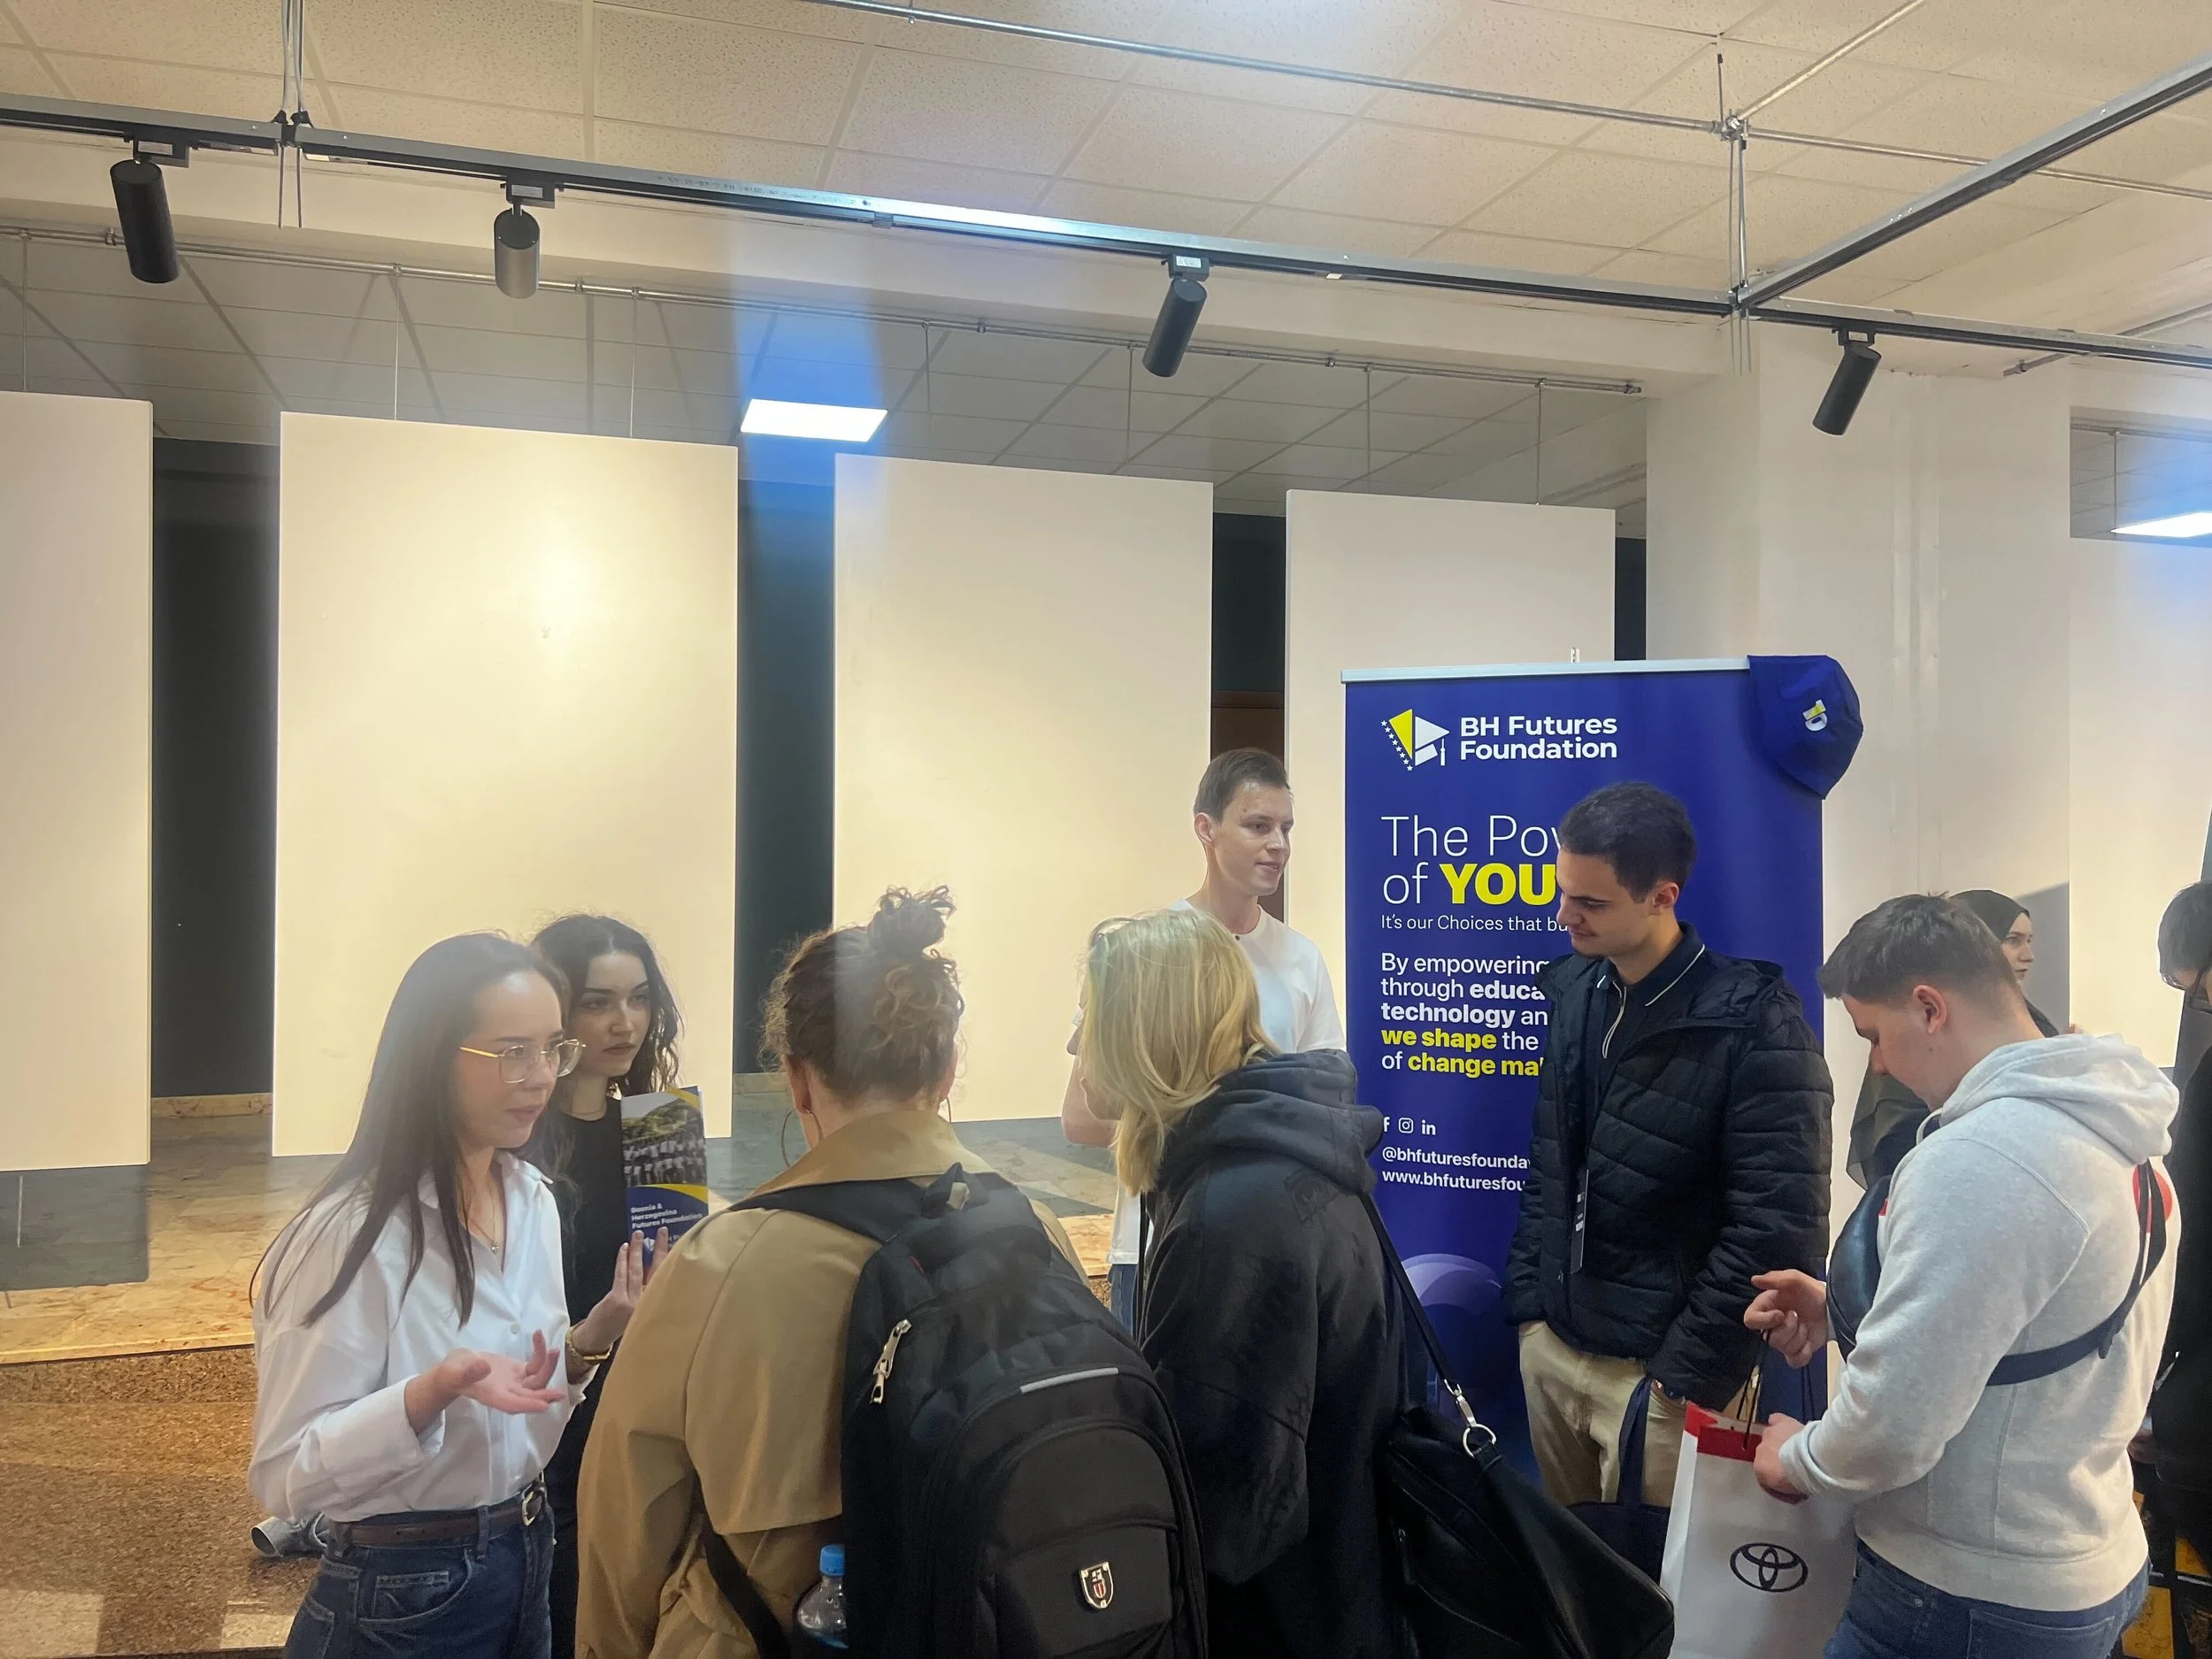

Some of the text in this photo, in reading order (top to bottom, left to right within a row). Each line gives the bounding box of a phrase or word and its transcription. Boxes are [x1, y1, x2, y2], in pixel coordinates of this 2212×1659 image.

[1461, 715, 1617, 737] BH Futures
[1460, 736, 1617, 760] Foundation
[1380, 814, 1469, 856] The
[1383, 862, 1557, 906] of YOU
[1381, 914, 1402, 929] It's
[1407, 918, 1433, 930] our
[1437, 915, 1503, 930] Choices
[1508, 917, 1542, 932] that
[1381, 952, 1409, 976] By
[1380, 977, 1463, 1002] through
[1380, 1002, 1548, 1029] technology an
[1380, 1027, 1539, 1053] we shape the
[1381, 1050, 1403, 1070] of
[1408, 1052, 1496, 1079] change
[1382, 1146, 1531, 1170] @bhfuturesfounda
[630, 1203, 657, 1214] Bosnia
[631, 1209, 678, 1221] Herzegovina
[632, 1220, 661, 1229] Futures
